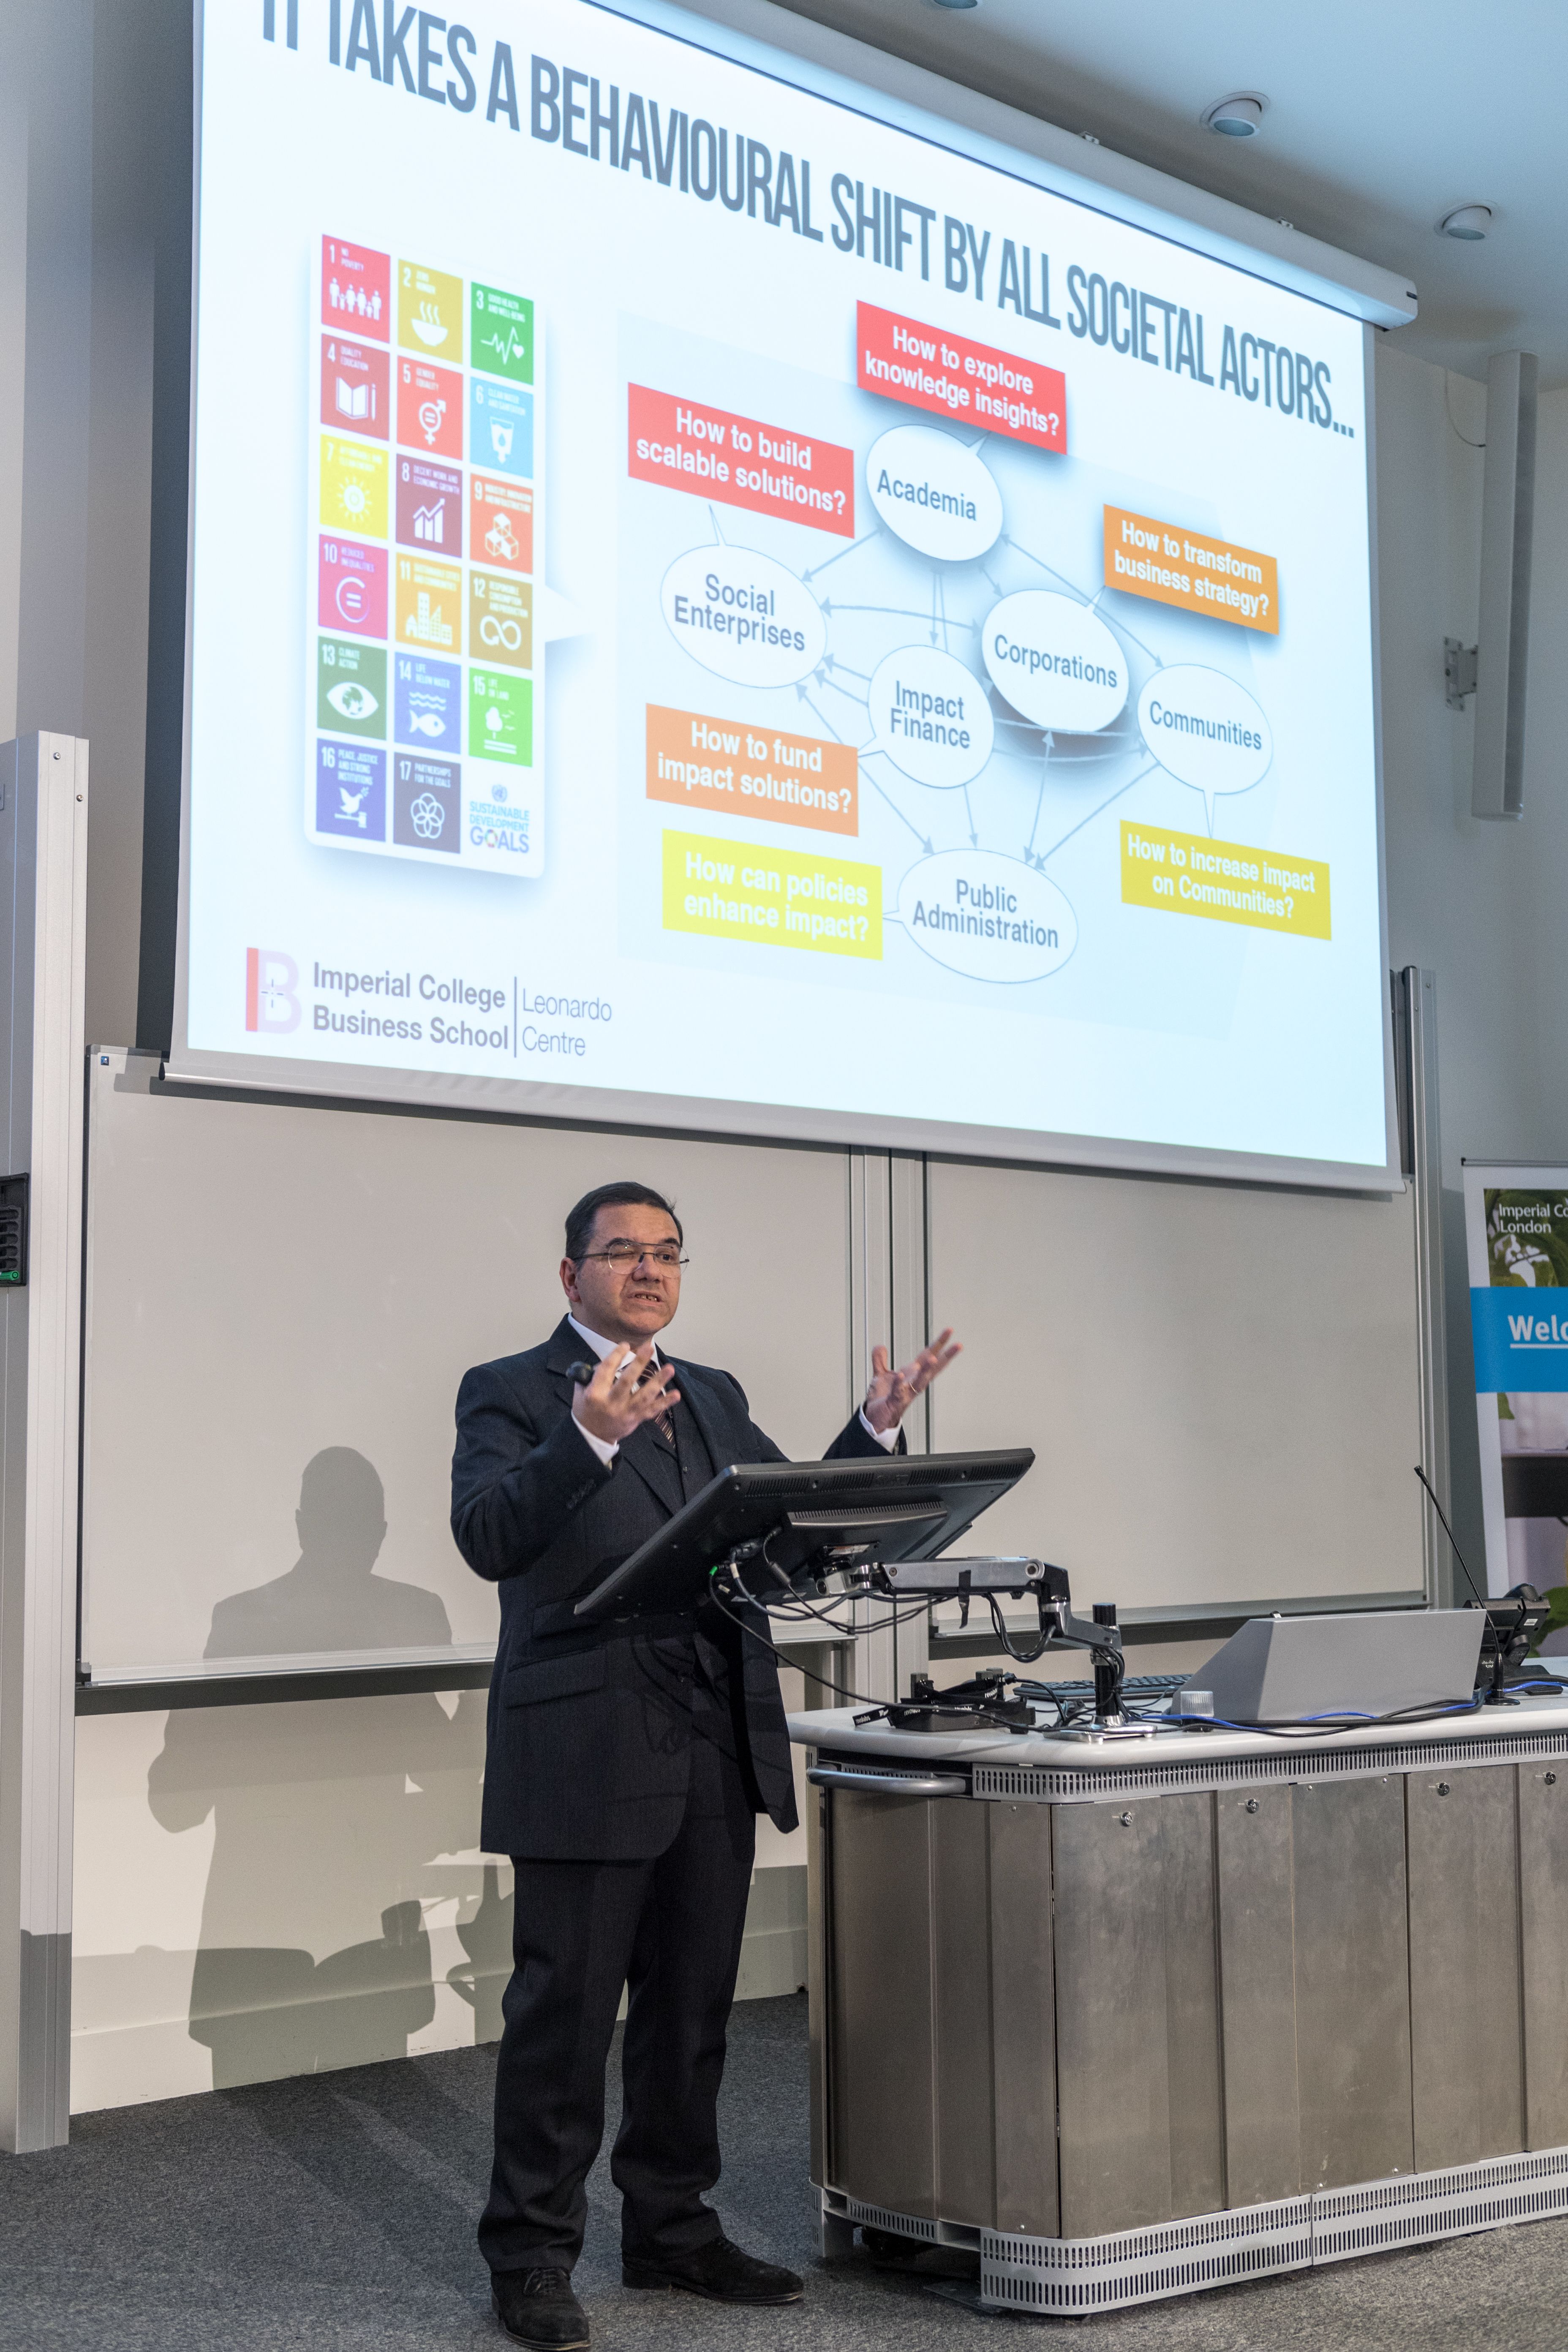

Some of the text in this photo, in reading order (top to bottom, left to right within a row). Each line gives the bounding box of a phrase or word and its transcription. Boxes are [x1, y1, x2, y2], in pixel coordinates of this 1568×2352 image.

[486, 40, 520, 132] A
[531, 54, 823, 243] BEHAVIOURAL
[831, 173, 936, 281] SHIFT
[945, 215, 991, 302] BY
[997, 238, 1061, 330] ALL
[1067, 265, 1214, 387] SOCIETAL
[330, 244, 335, 263] 1
[403, 267, 411, 287] 2
[476, 290, 484, 310] 3
[327, 343, 335, 362] 4
[893, 326, 1033, 396] How to explore
[403, 363, 411, 384] 5
[476, 384, 484, 404] 6
[865, 351, 1059, 436] knowledge insights?
[327, 442, 334, 462] 7
[676, 407, 811, 470] How to build
[402, 462, 410, 482] 8
[637, 438, 846, 515] scalable solutions?
[475, 481, 482, 500] 9
[877, 469, 977, 521] Academia
[324, 543, 338, 564] 10
[1122, 520, 1262, 584] How to transform
[400, 560, 411, 581] 11
[474, 577, 486, 598] 12
[1115, 550, 1269, 618] business strategy?
[705, 574, 775, 616] Social
[675, 595, 805, 651] Enterprises
[322, 644, 335, 666] 13
[399, 659, 411, 681] 14
[994, 634, 1117, 688] Corporations
[474, 675, 485, 696] 15
[896, 681, 965, 721] Impact
[891, 708, 970, 749] Finance
[1149, 700, 1262, 750] Communities
[321, 746, 335, 768] 16
[691, 721, 822, 773] How to fund
[399, 760, 411, 781] 17
[657, 752, 852, 813] impact solutions?
[470, 801, 529, 821] SUSTAINABLE
[470, 814, 529, 832] DEVELOPMENT
[470, 825, 529, 853] GOALS
[685, 851, 868, 906] How can policies
[1127, 833, 1315, 893] How to increase impact
[956, 878, 1017, 913] Public
[1152, 875, 1293, 918] on Communities?
[684, 893, 868, 941] enhance impact?
[913, 901, 1058, 949] Administration
[314, 962, 506, 1013] Imperial College
[523, 988, 612, 1021] Leonardo
[313, 1004, 509, 1050] Business School
[522, 1026, 586, 1056] Centre
[1499, 1203, 1550, 1221] Imperial
[1500, 1219, 1552, 1234] London
